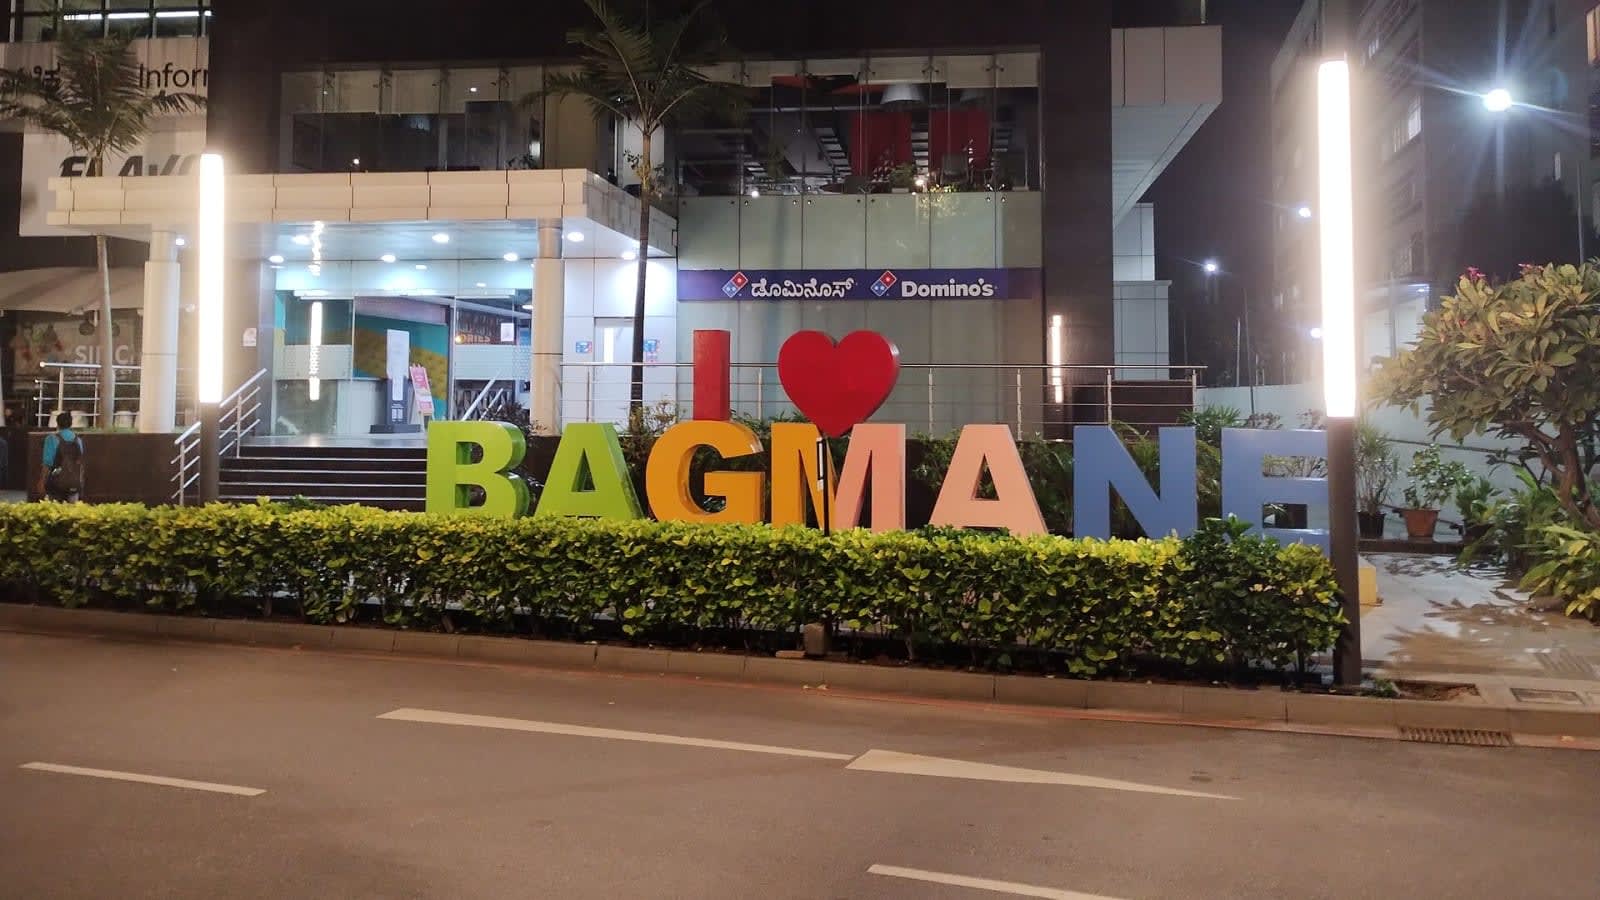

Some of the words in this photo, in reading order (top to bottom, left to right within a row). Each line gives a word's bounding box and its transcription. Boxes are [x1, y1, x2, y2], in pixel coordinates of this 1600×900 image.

[139, 62, 208, 88] Infor
[901, 278, 995, 297] Domino's
[426, 419, 1330, 543] BAGMANE
